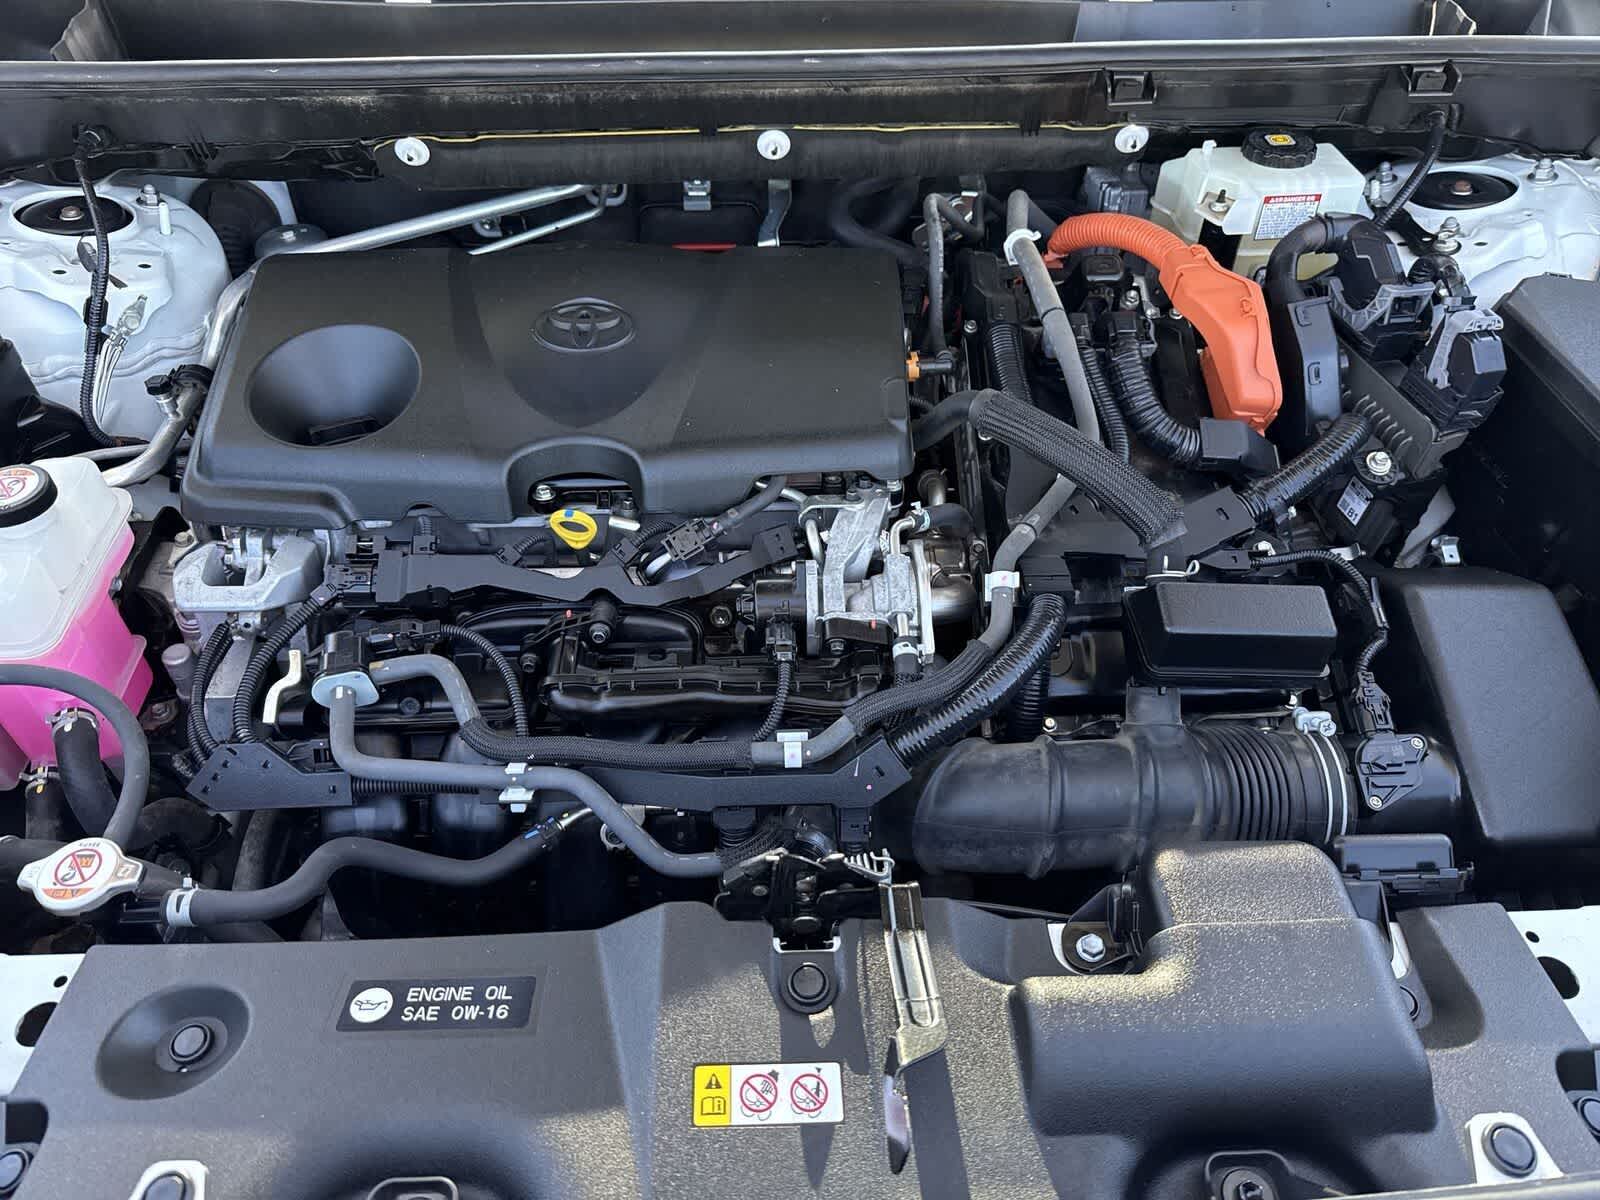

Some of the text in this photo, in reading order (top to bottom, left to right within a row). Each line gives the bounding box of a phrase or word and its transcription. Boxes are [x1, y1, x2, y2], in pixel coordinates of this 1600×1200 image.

[1347, 507, 1358, 521] B1
[406, 985, 512, 1002] ENGINE OIL
[401, 1004, 509, 1021] SAE 0W-16
